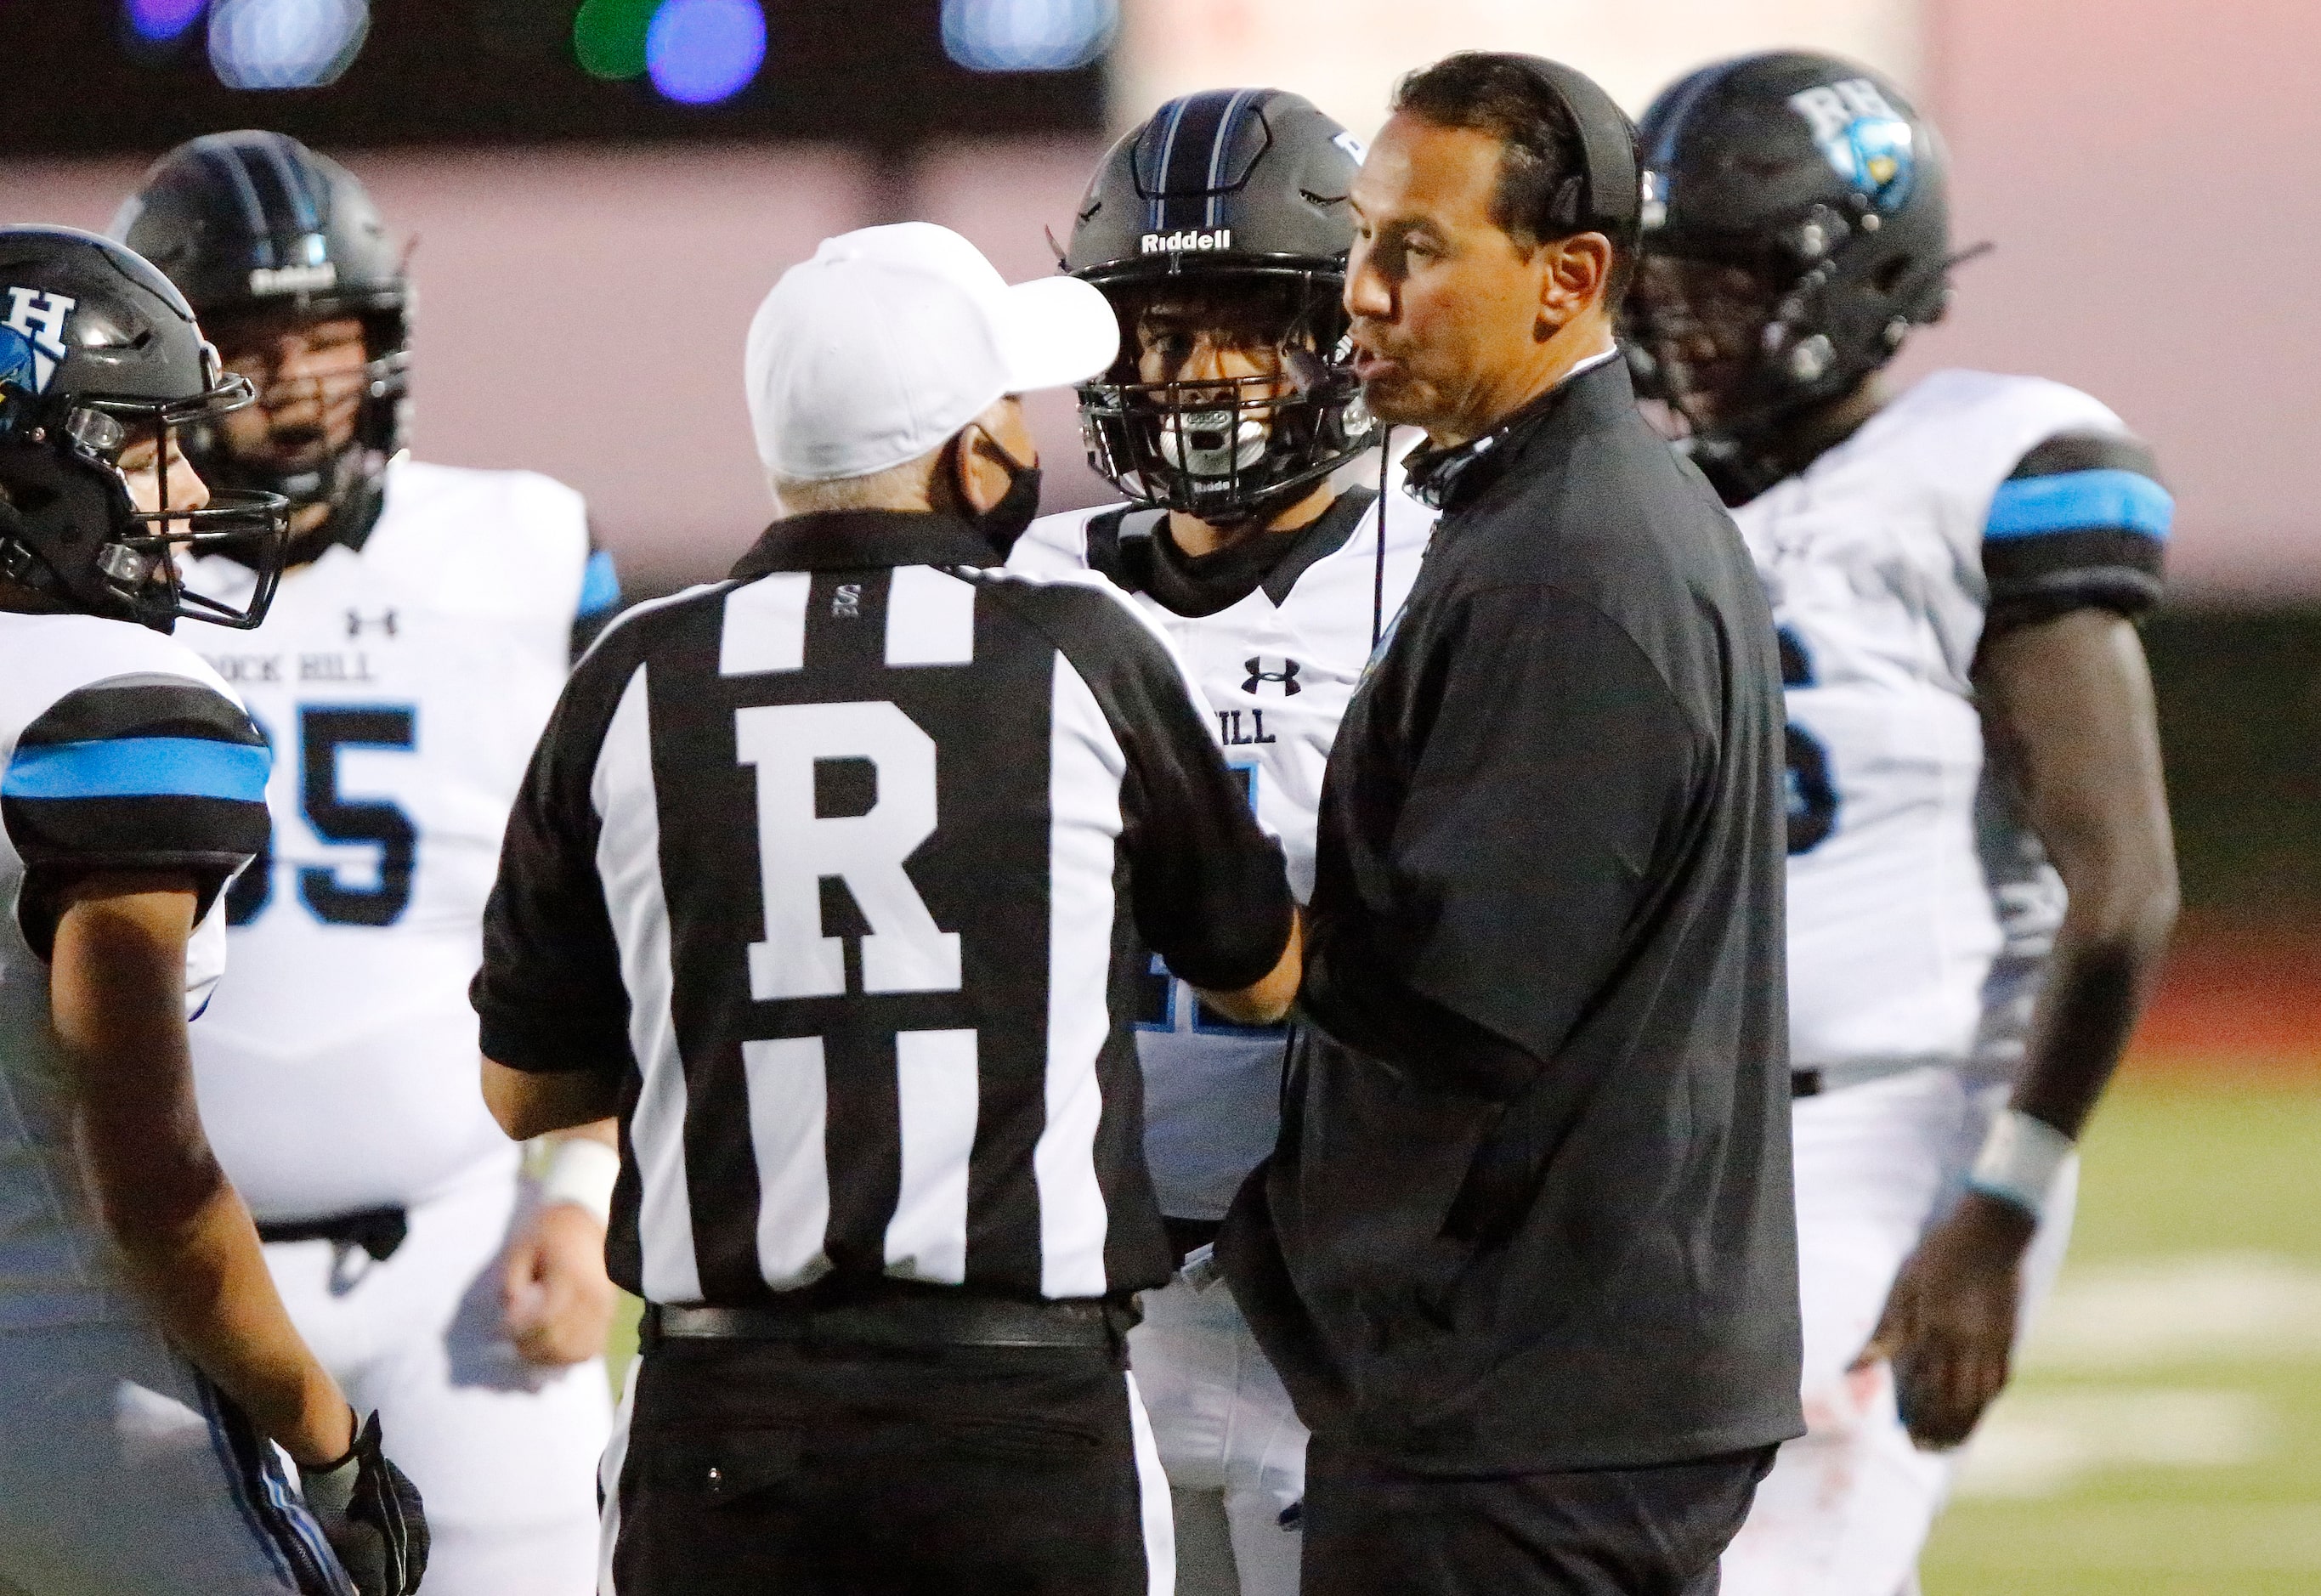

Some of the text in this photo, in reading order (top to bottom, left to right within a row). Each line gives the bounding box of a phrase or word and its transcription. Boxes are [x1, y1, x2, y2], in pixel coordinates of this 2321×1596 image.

[1141, 229, 1231, 254] Riddell
[2, 286, 76, 359] H
[201, 652, 282, 682] OCK
[1214, 708, 1277, 745] ILL
[735, 700, 962, 1001] R
